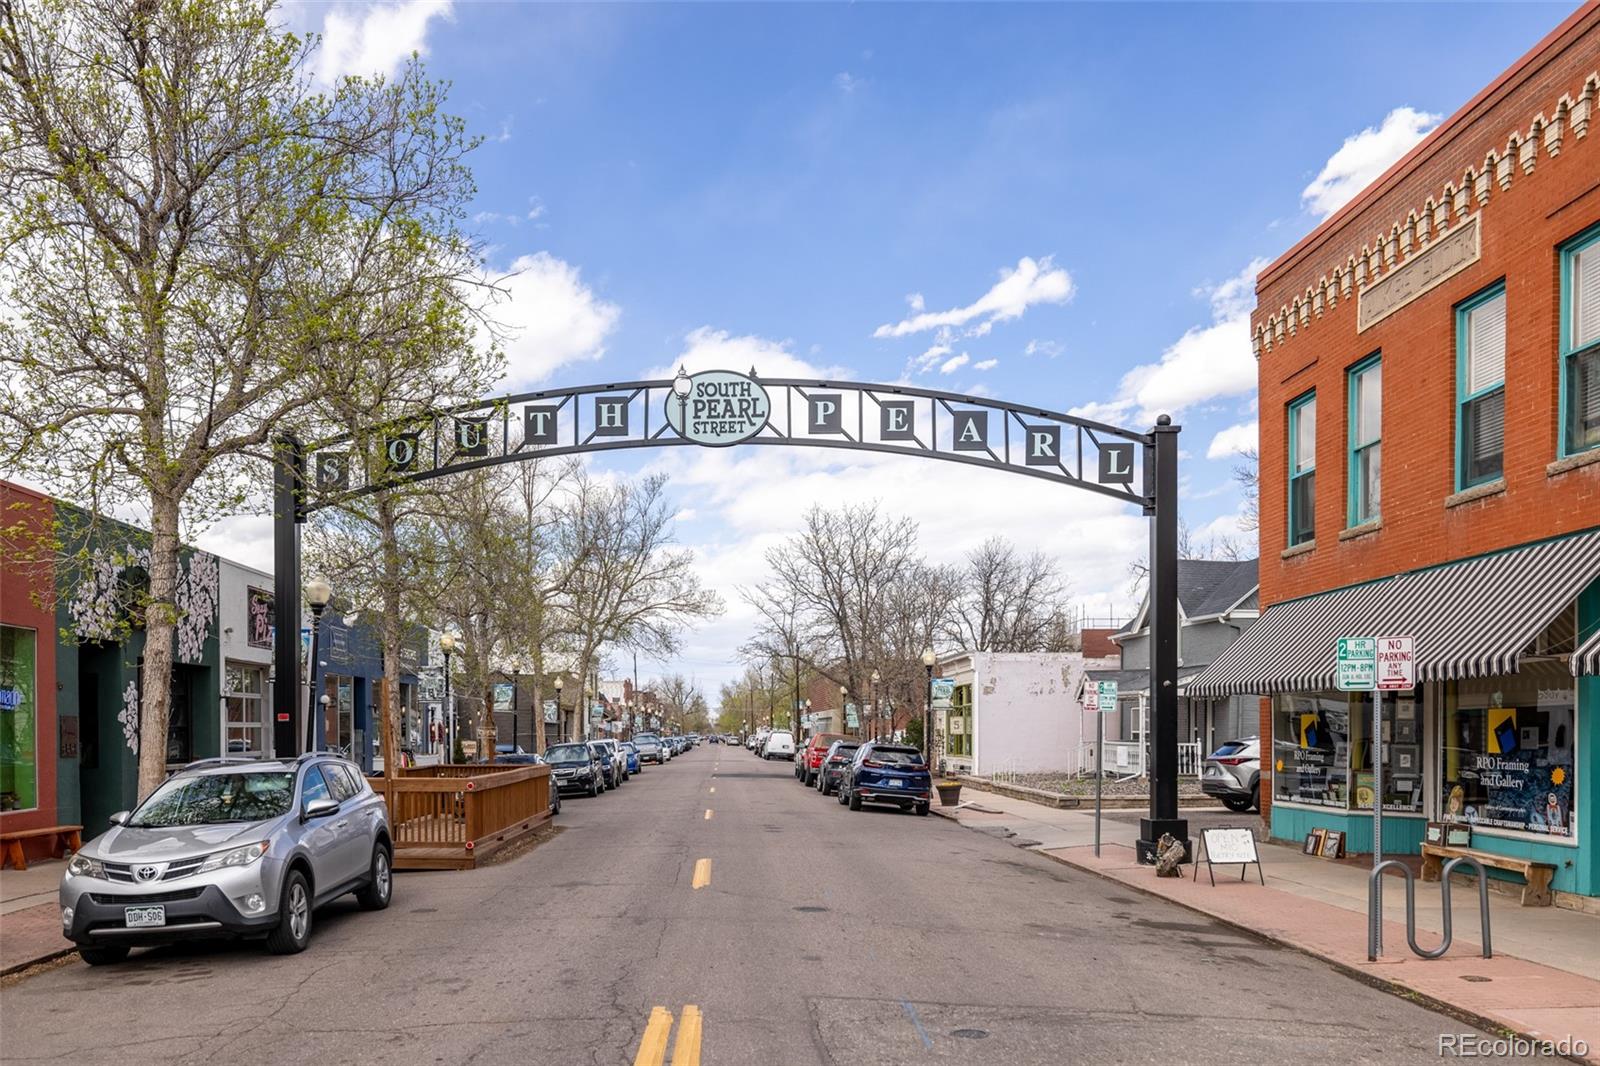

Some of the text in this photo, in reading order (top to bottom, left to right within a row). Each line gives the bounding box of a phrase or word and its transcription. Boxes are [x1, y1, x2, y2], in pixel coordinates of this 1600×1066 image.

[697, 381, 752, 398] SOUTH
[692, 397, 765, 426] PEARL
[693, 420, 746, 436] STREET
[1340, 643, 1346, 657] 2
[1354, 640, 1366, 649] HR
[1388, 640, 1402, 650] NO
[1348, 649, 1374, 658] PARKING
[1378, 652, 1411, 662] PARKING
[1306, 751, 1324, 763] Framing
[1476, 756, 1530, 773] RPO Framing
[1480, 774, 1524, 790] and Gallery
[1382, 803, 1416, 811] XCELLENCE
